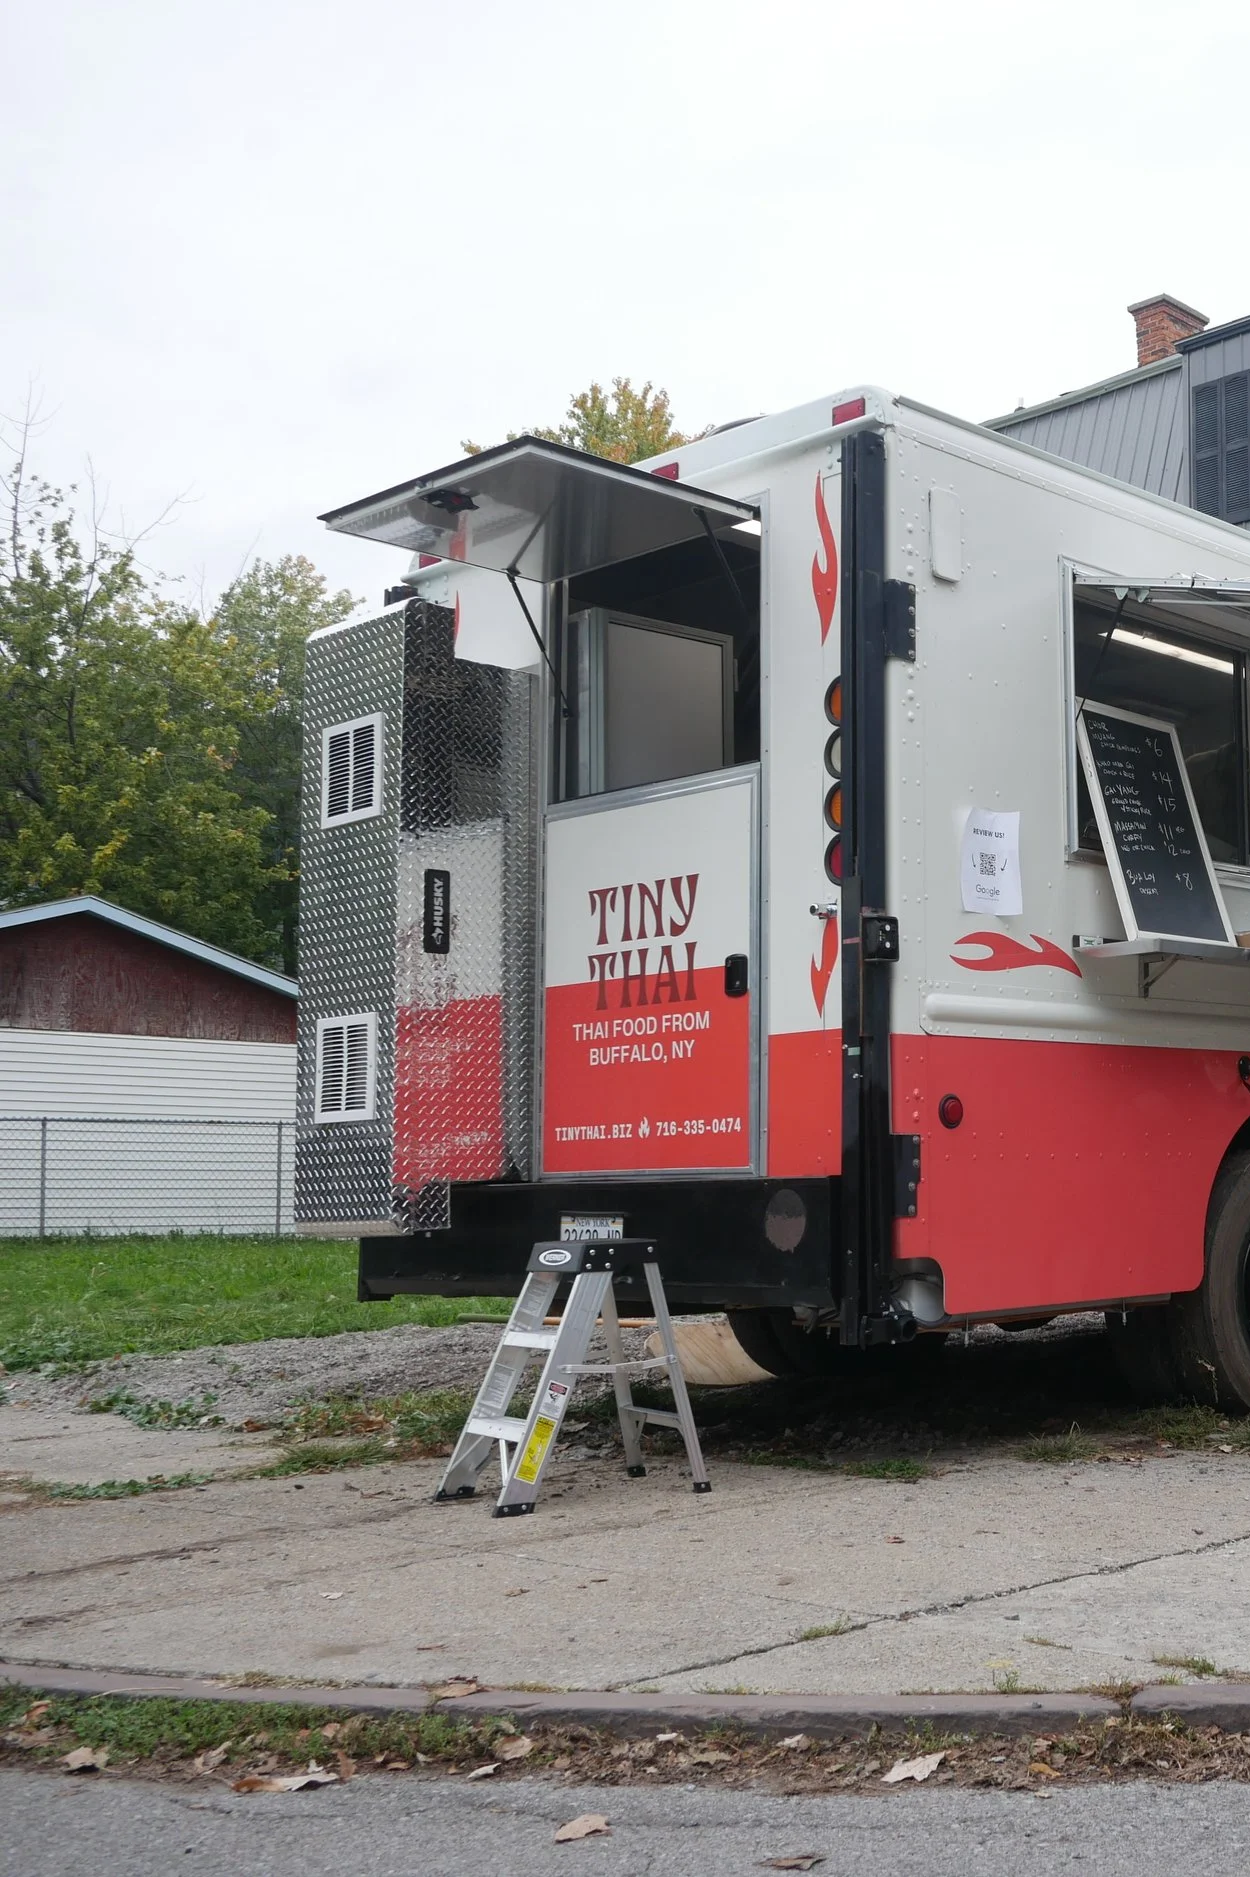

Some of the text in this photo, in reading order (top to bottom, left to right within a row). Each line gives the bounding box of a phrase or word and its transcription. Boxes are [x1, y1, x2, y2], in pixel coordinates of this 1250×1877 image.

[1116, 784, 1140, 796] YANG
[973, 827, 993, 837] REVIEW
[433, 877, 444, 927] HUSKY
[976, 884, 1000, 897] Google
[588, 873, 699, 946] TINY
[587, 941, 698, 1011] THAI
[573, 1010, 710, 1042] THAI FOOD FROM
[588, 1039, 695, 1066] BUFFALO, NY
[555, 1117, 742, 1142] TINYTHAI.BIZ 716-335-0474
[576, 1217, 610, 1228] NEW YORK
